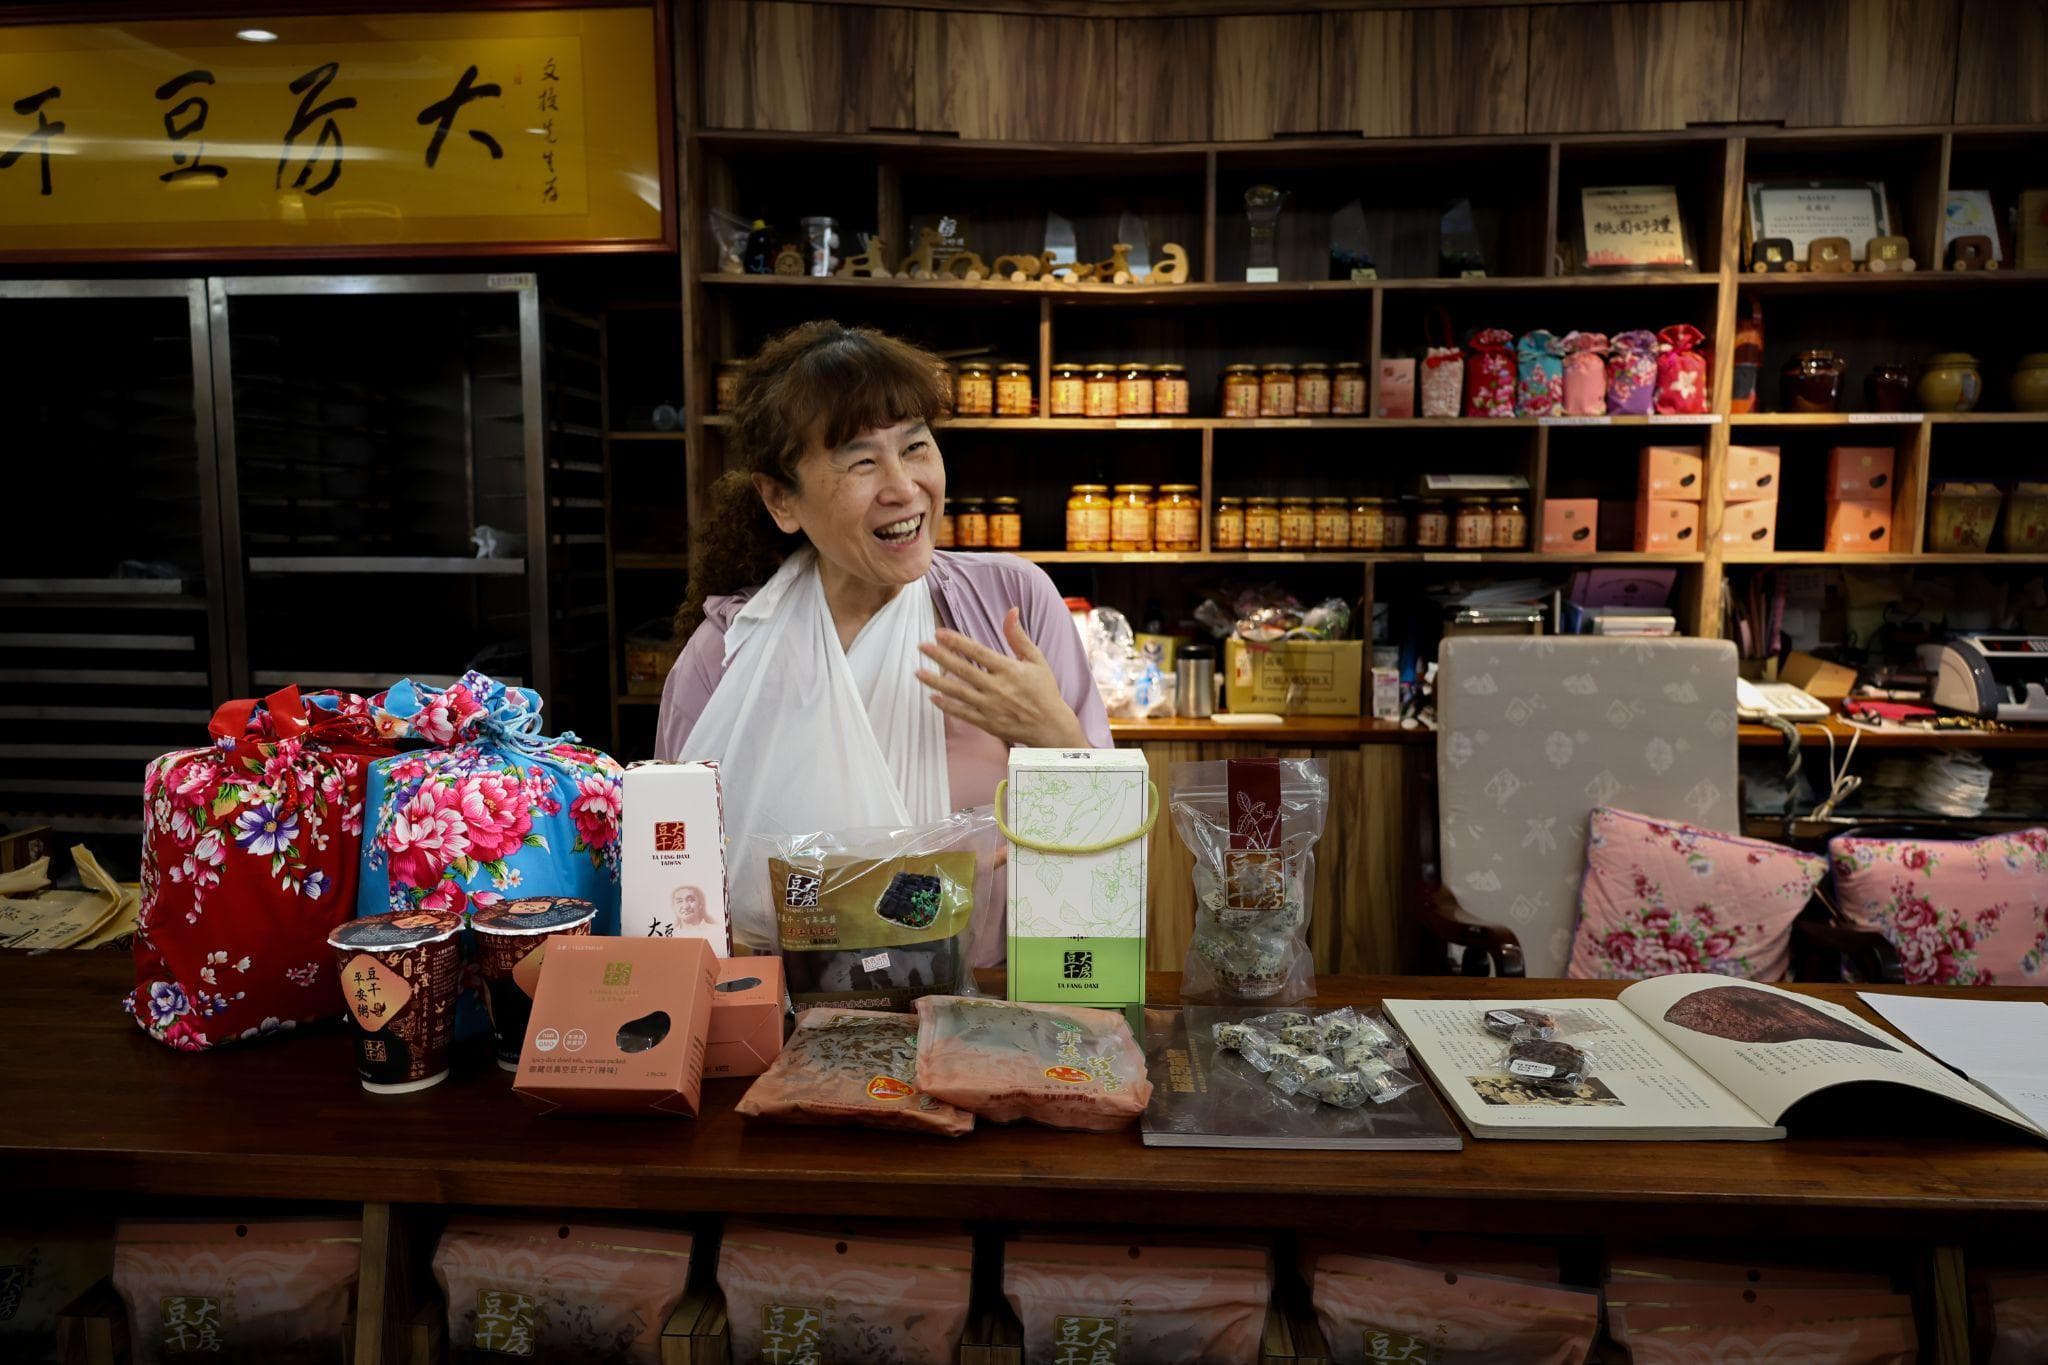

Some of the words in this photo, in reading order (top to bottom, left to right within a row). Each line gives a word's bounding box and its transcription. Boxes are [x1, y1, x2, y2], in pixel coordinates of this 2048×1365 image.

[353, 971, 370, 1018] 平安粥
[366, 967, 381, 996] 豆干
[164, 1297, 197, 1351] 豆干
[195, 1298, 224, 1352] 大房
[475, 1291, 505, 1352] 豆干
[502, 1295, 534, 1355] 大房
[761, 1306, 792, 1365] 豆干
